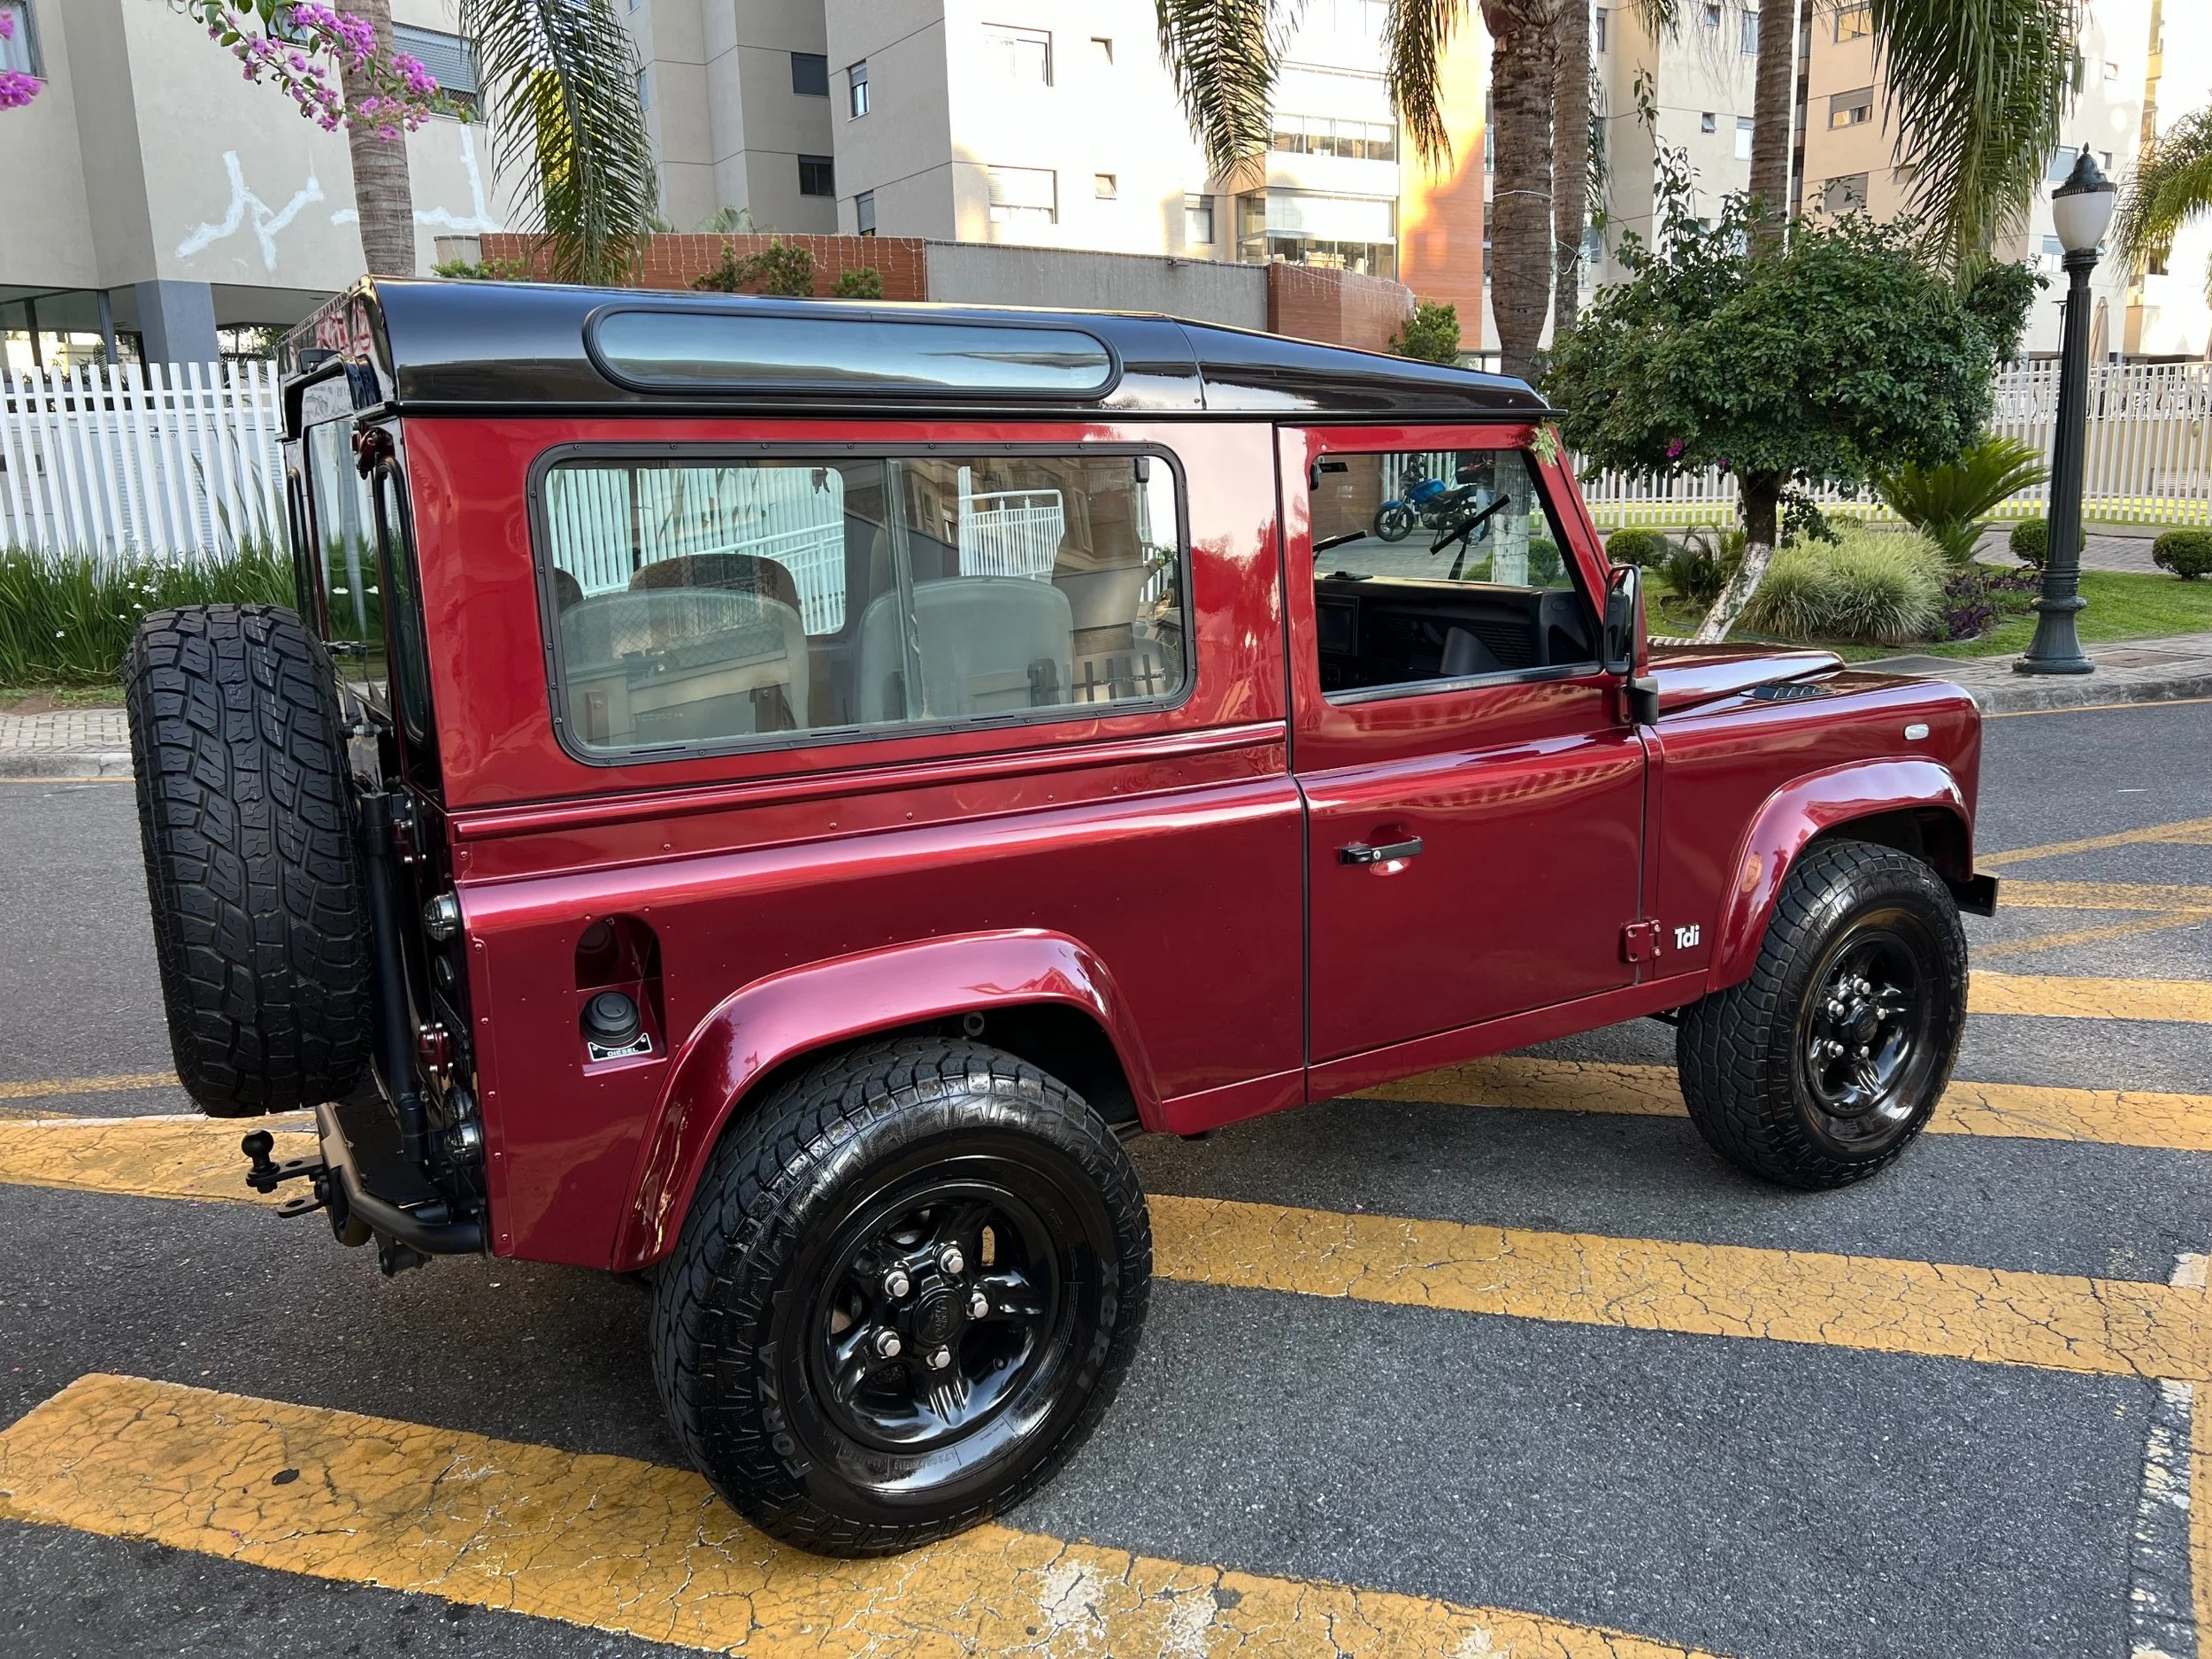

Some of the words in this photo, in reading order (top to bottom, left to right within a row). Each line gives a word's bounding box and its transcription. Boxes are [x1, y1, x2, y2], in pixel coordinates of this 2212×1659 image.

[1673, 923, 1700, 949] Tdi
[606, 1047, 639, 1057] DIESEL
[1076, 1257, 1120, 1391] XBRI
[756, 1340, 815, 1480] FORZA
